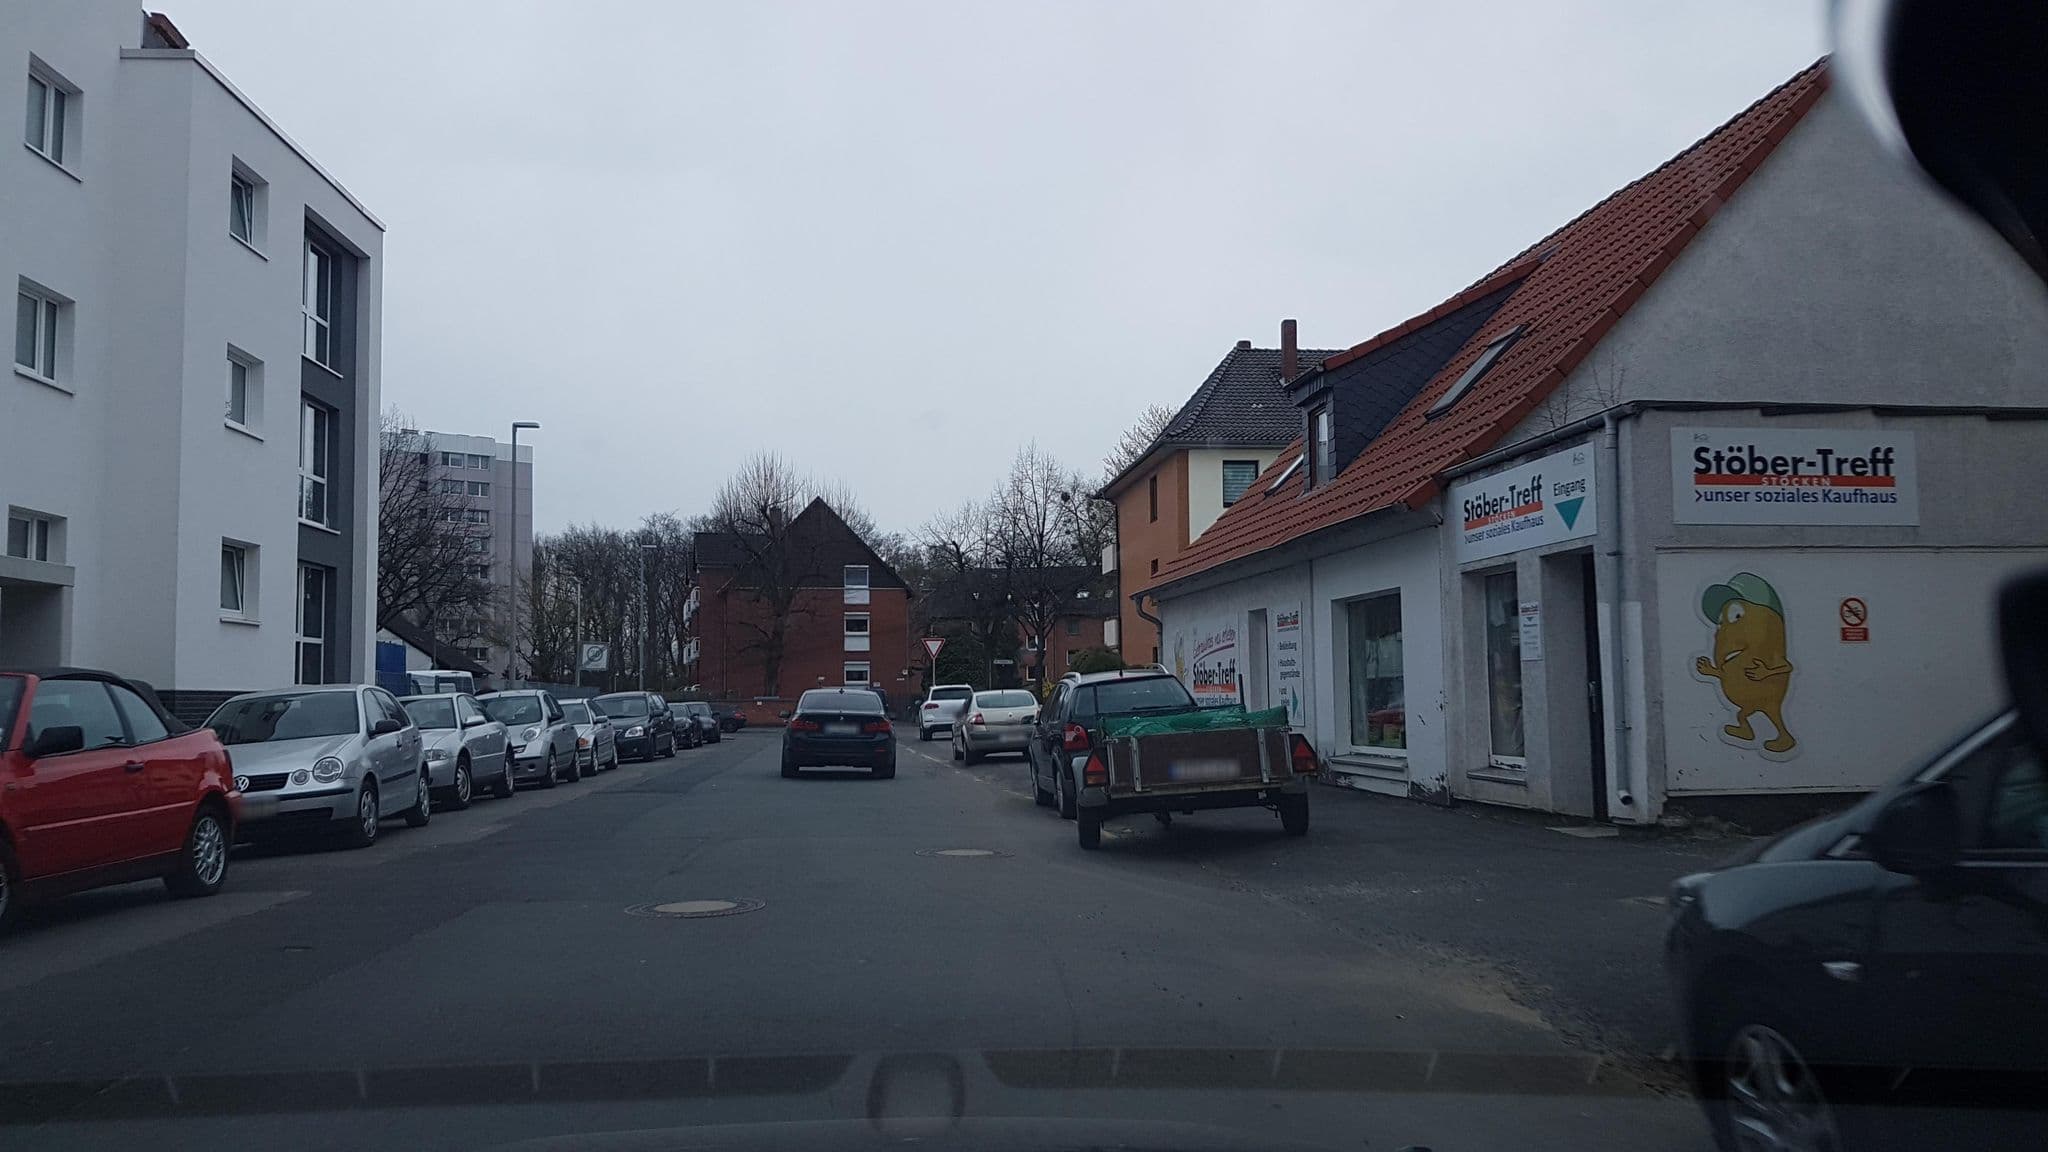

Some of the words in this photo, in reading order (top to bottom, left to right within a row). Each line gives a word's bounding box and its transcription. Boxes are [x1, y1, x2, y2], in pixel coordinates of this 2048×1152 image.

[1693, 445, 1895, 476] Stöber-Treff
[1463, 474, 1543, 522] Stöber-Treff
[1553, 478, 1586, 497] Eingang
[1755, 488, 1818, 503] soziales
[1822, 489, 1897, 504] Kaufhaus
[1486, 523, 1511, 538] soziales
[1511, 515, 1545, 533] Kaufhaus
[1193, 658, 1235, 685] Stöber-Treff
